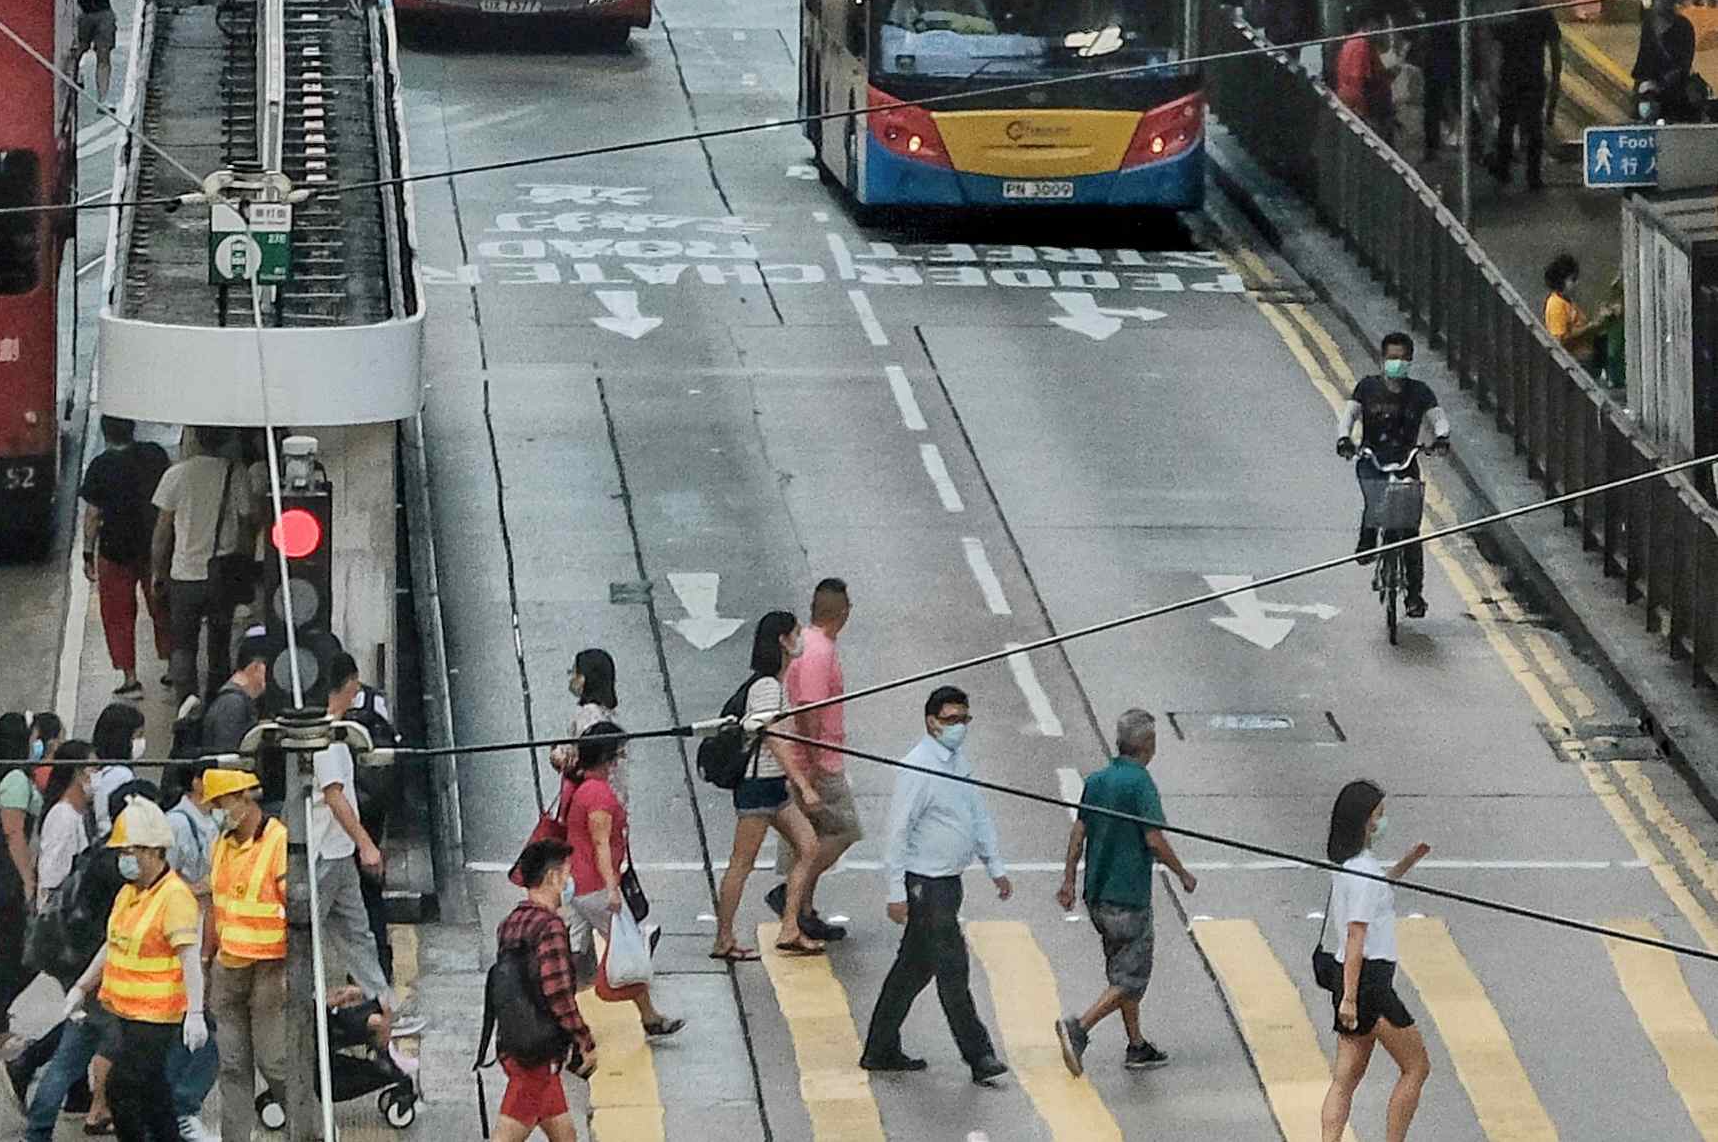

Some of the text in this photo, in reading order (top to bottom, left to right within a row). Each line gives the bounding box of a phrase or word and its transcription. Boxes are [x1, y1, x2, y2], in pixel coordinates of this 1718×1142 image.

[477, 239, 758, 259] ROAD
[421, 263, 826, 284] CHATER
[855, 264, 1246, 293] PEDDER
[6, 466, 35, 490] 52
